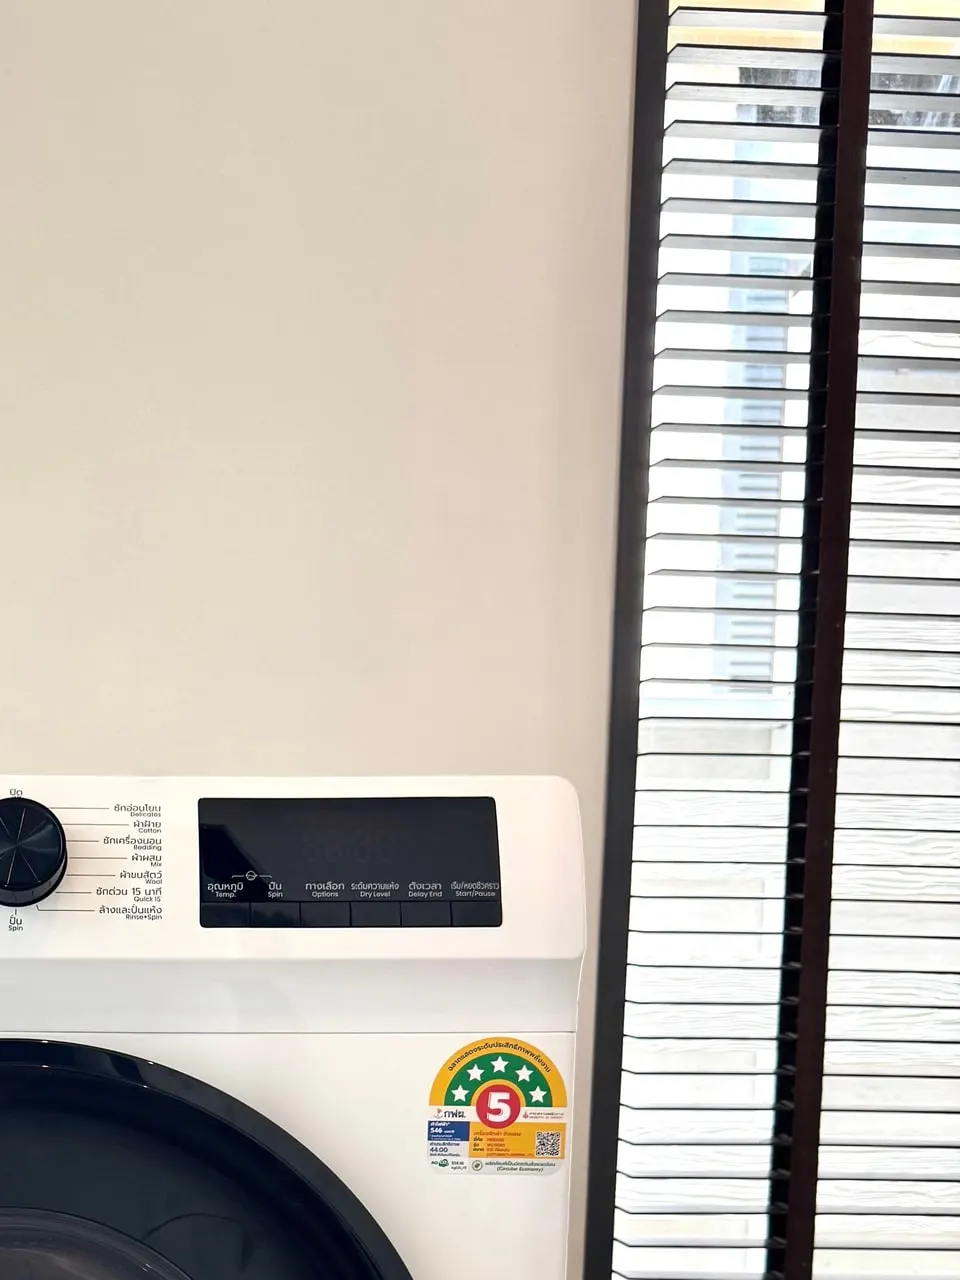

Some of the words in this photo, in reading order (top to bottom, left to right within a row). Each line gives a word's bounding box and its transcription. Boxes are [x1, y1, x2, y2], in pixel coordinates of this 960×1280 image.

[133, 844, 162, 852] Bedding
[305, 881, 345, 891] ทางเลือก
[132, 887, 141, 896] 15
[144, 886, 162, 896] นาที
[215, 891, 237, 899] Temp.
[311, 890, 339, 898] Options
[373, 890, 391, 898] Level
[408, 890, 428, 899] Delay
[455, 890, 496, 898] Start/Pause
[8, 924, 24, 932] Spin
[487, 1091, 512, 1123] 5
